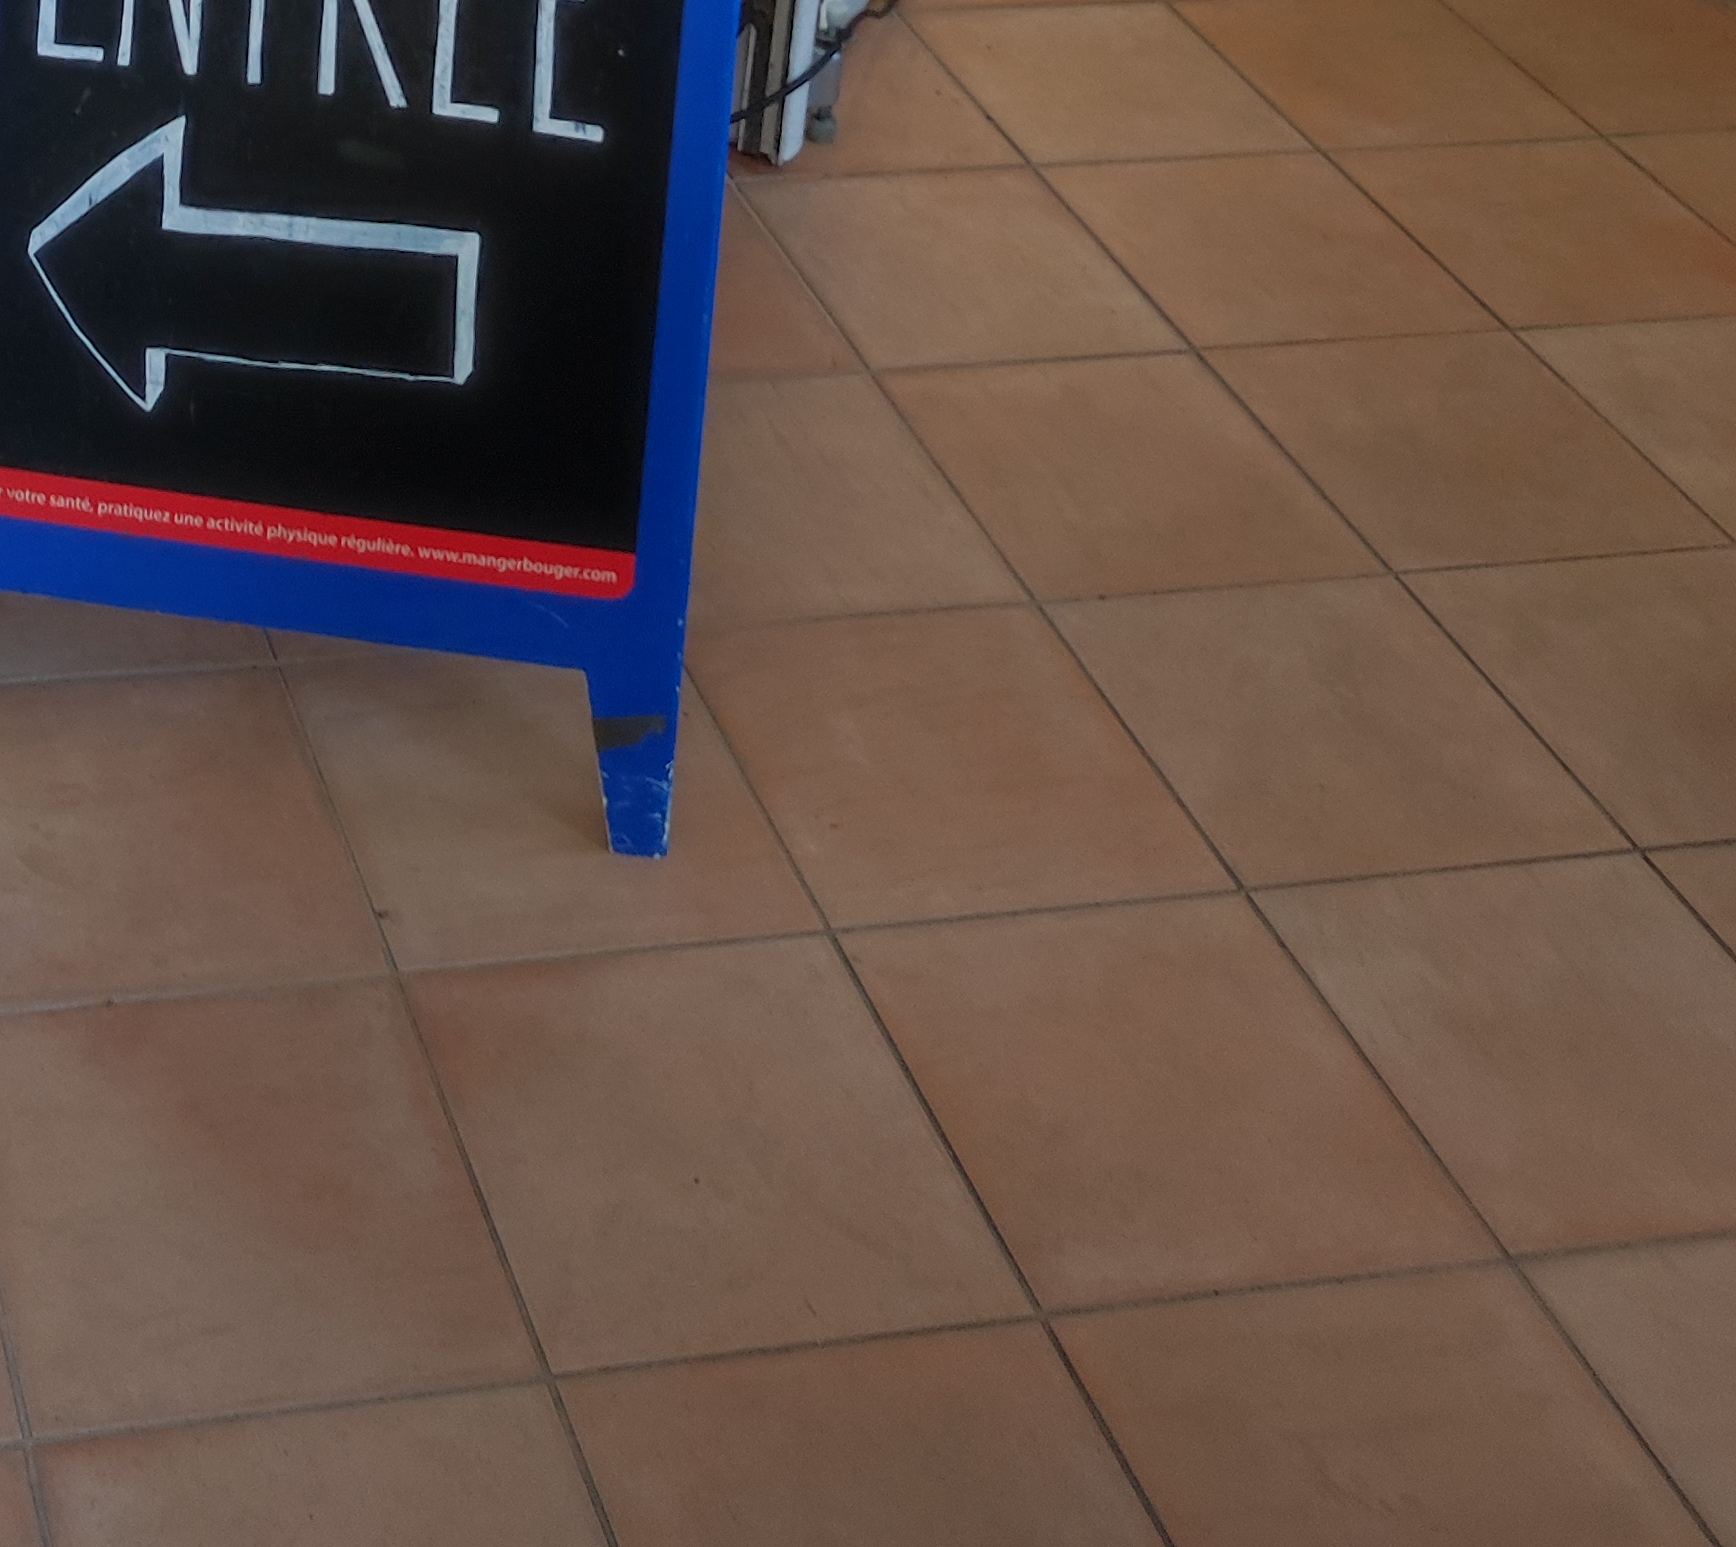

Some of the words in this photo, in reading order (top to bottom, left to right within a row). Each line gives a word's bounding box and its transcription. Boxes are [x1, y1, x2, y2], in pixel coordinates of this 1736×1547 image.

[6, 486, 47, 506] votre
[49, 491, 94, 514] santé,
[97, 498, 171, 524] pratiquez
[174, 509, 204, 528] une
[206, 512, 264, 536] activité
[266, 524, 339, 549] physique
[417, 545, 619, 585] www.mangerbouger.com
